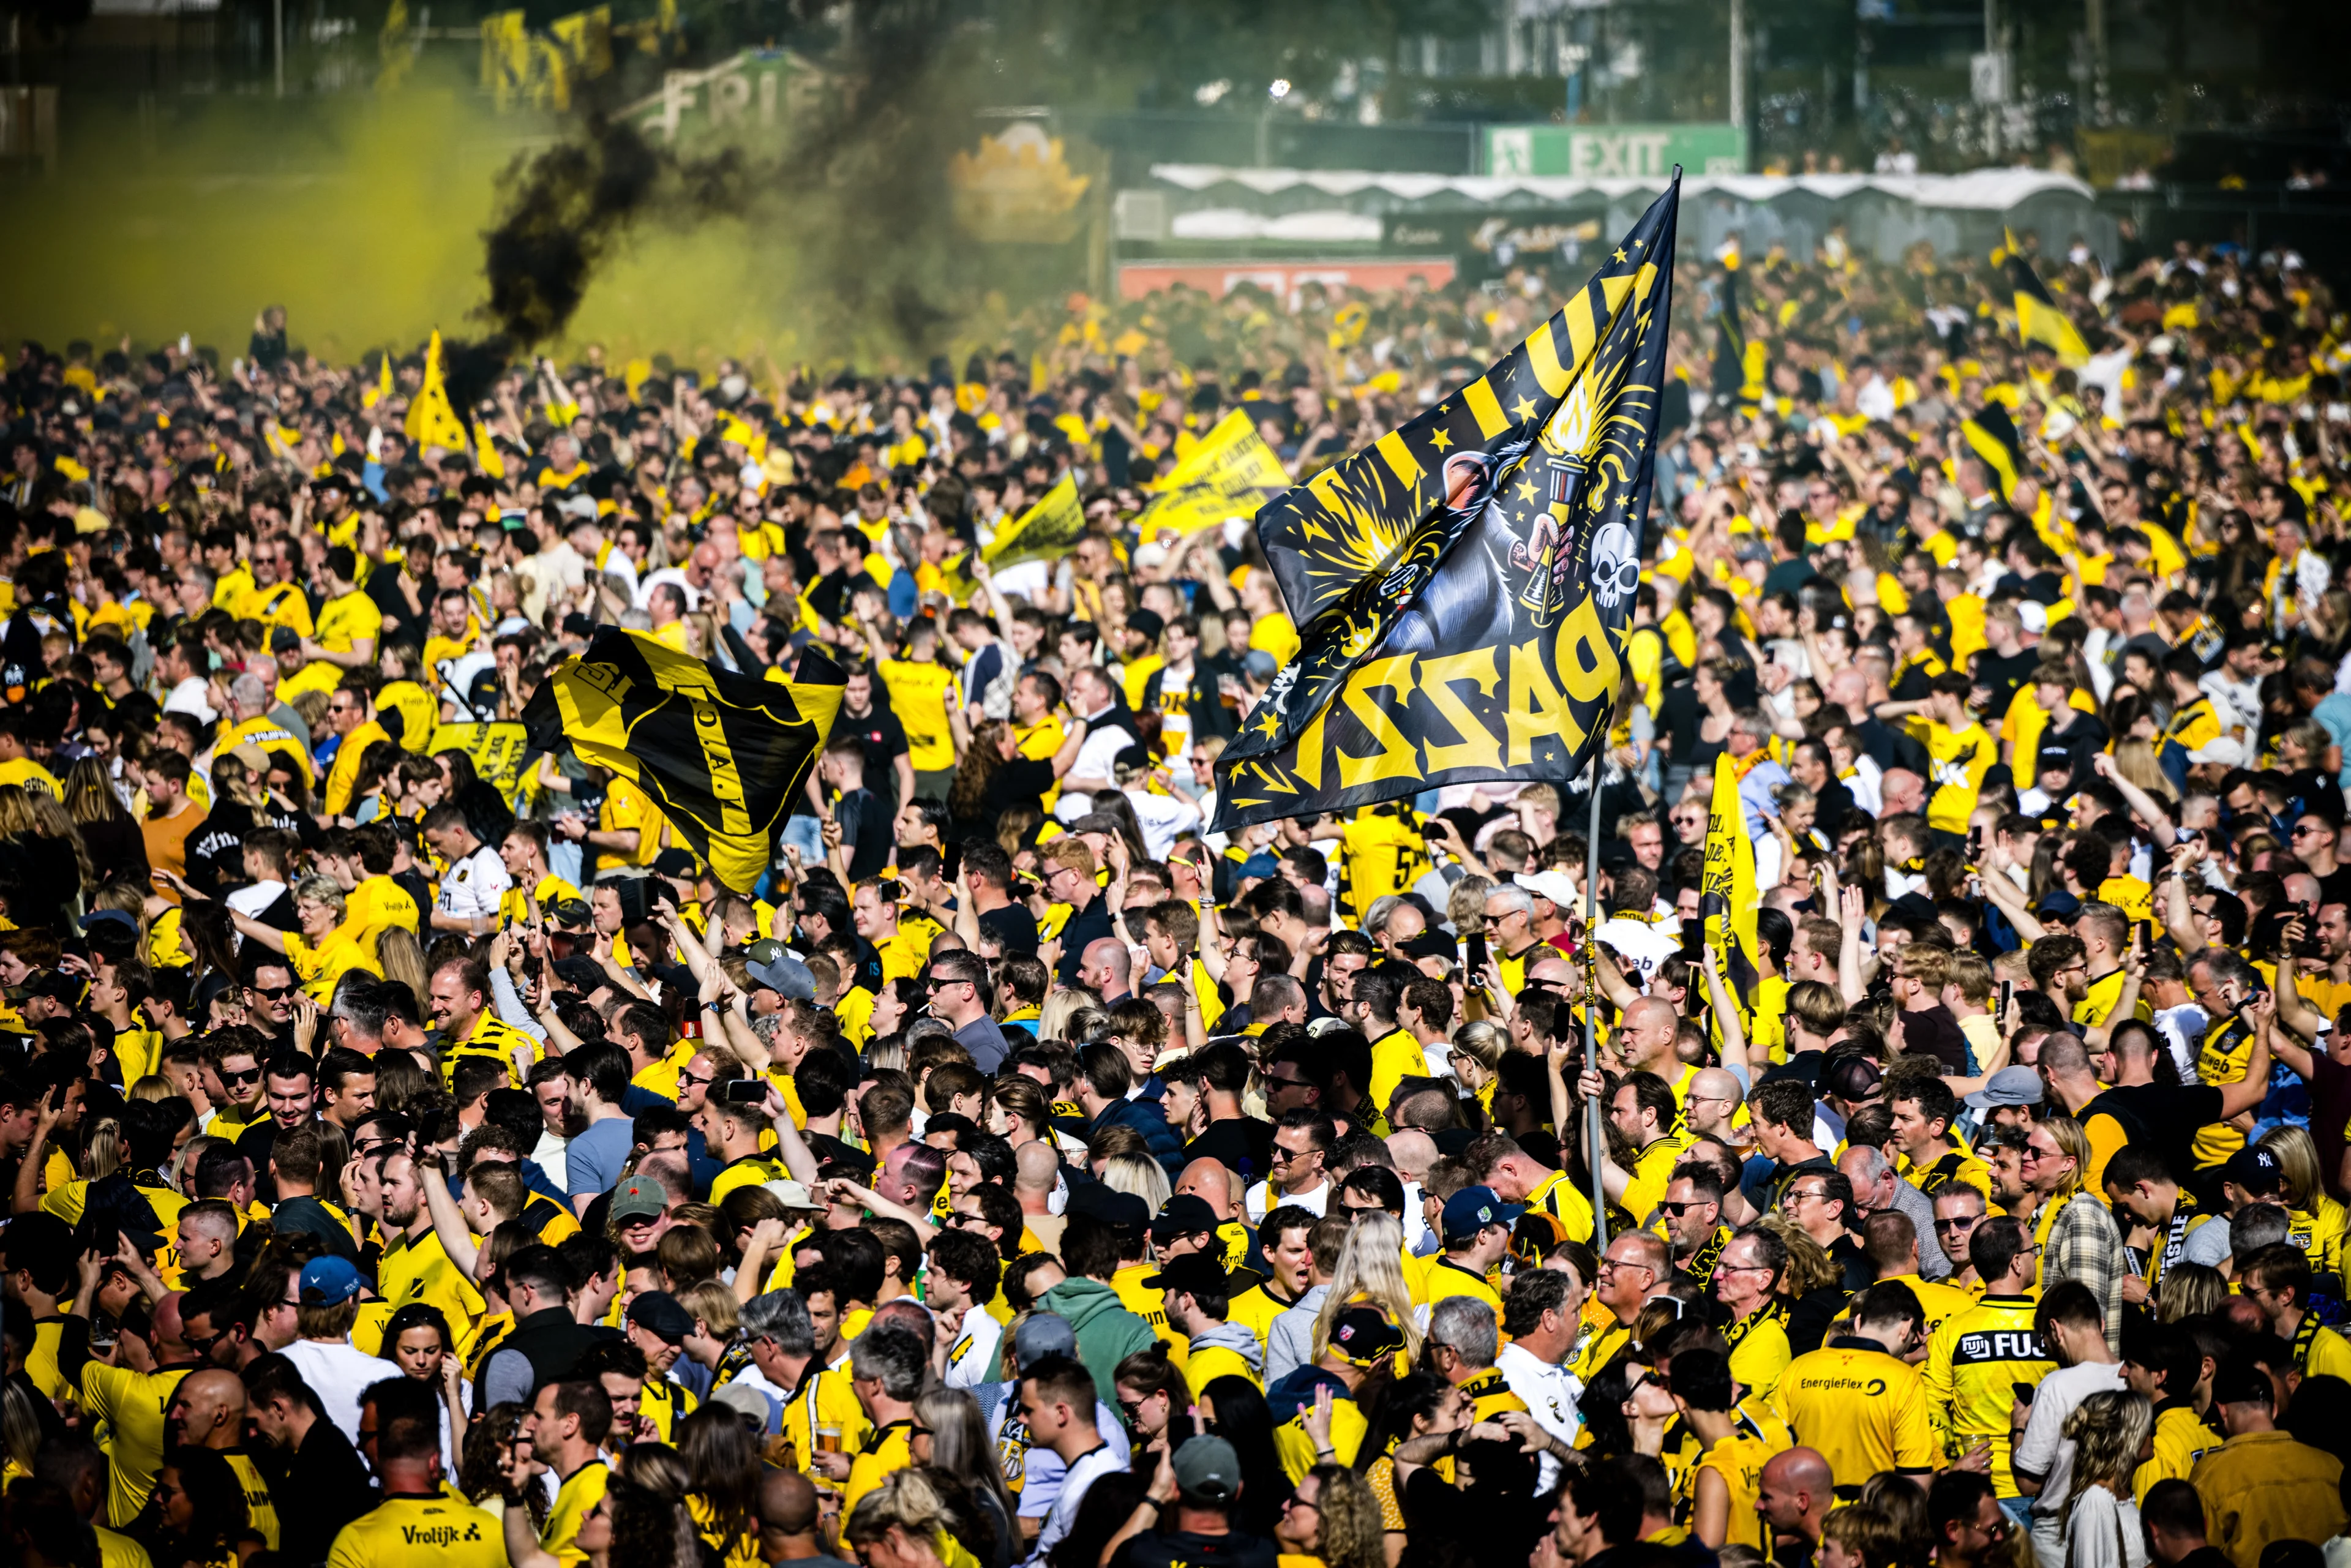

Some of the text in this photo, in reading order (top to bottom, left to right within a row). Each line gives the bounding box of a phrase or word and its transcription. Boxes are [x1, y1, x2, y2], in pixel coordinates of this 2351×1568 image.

[1570, 134, 1670, 175] EXIT
[2257, 1152, 2273, 1167] NY
[345, 1277, 359, 1294] TOUR
[1801, 1378, 1863, 1391] EnergieFlex
[402, 1525, 459, 1548] Vrolijk
